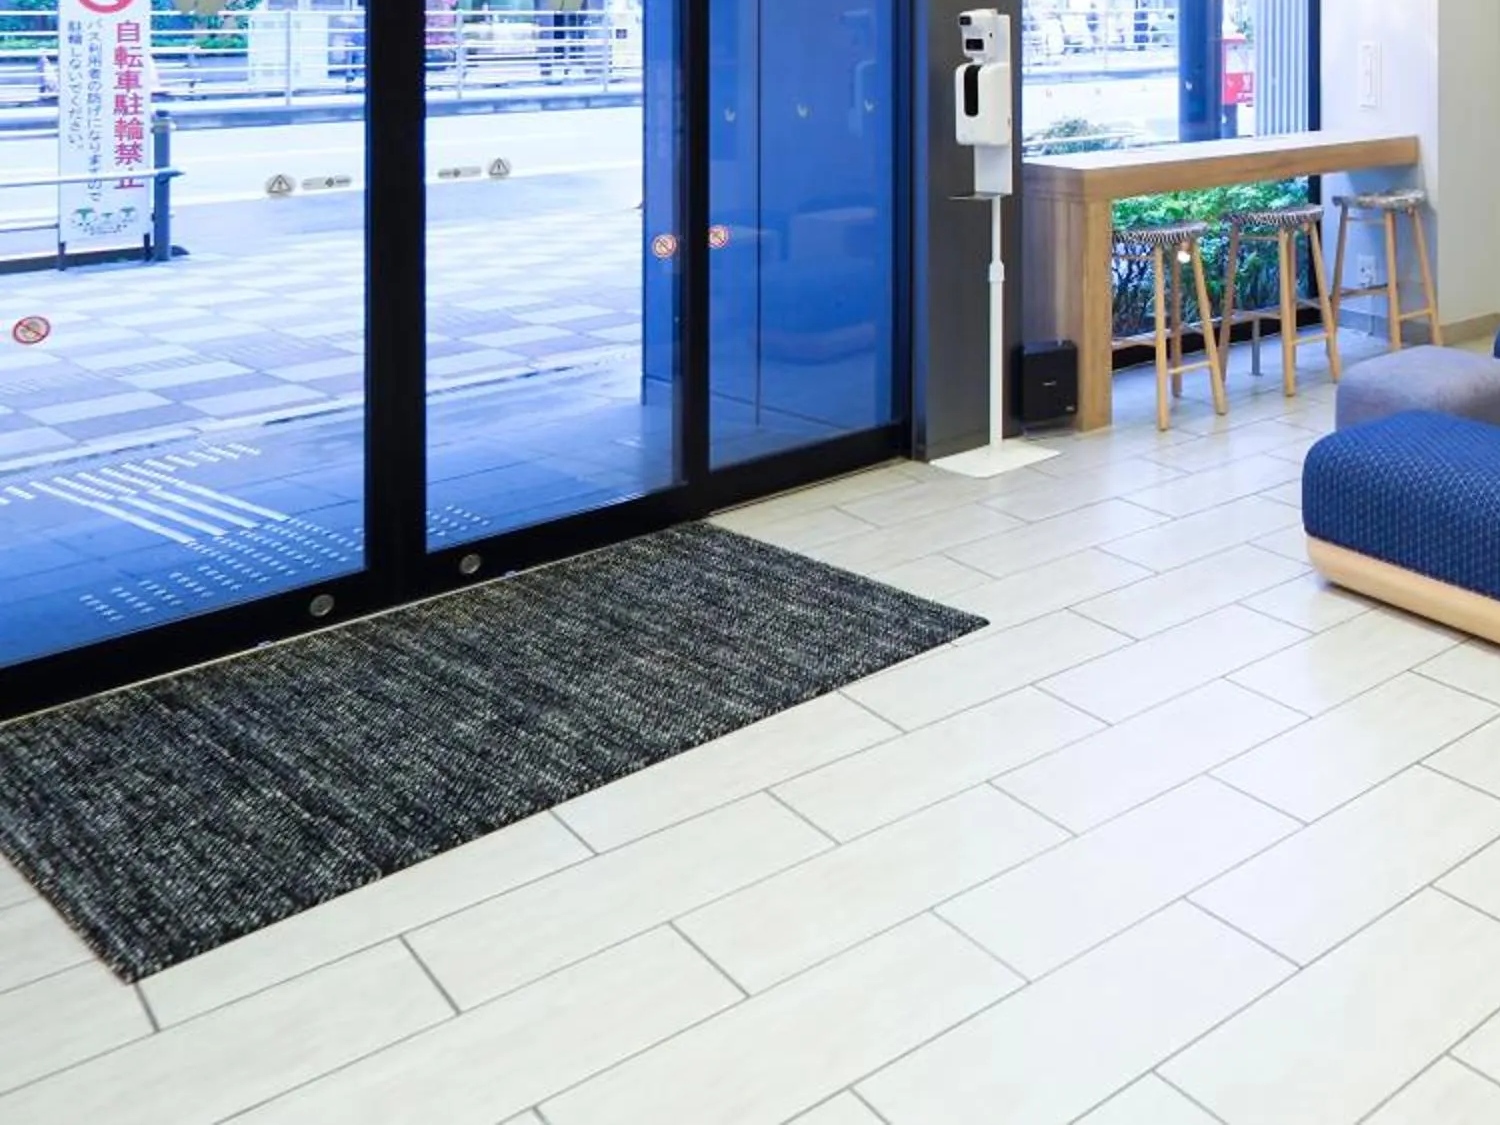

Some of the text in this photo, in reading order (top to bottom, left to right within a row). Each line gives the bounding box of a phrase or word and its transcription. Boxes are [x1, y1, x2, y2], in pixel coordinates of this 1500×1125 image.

[112, 20, 144, 189] 自転車駐輪禁止
